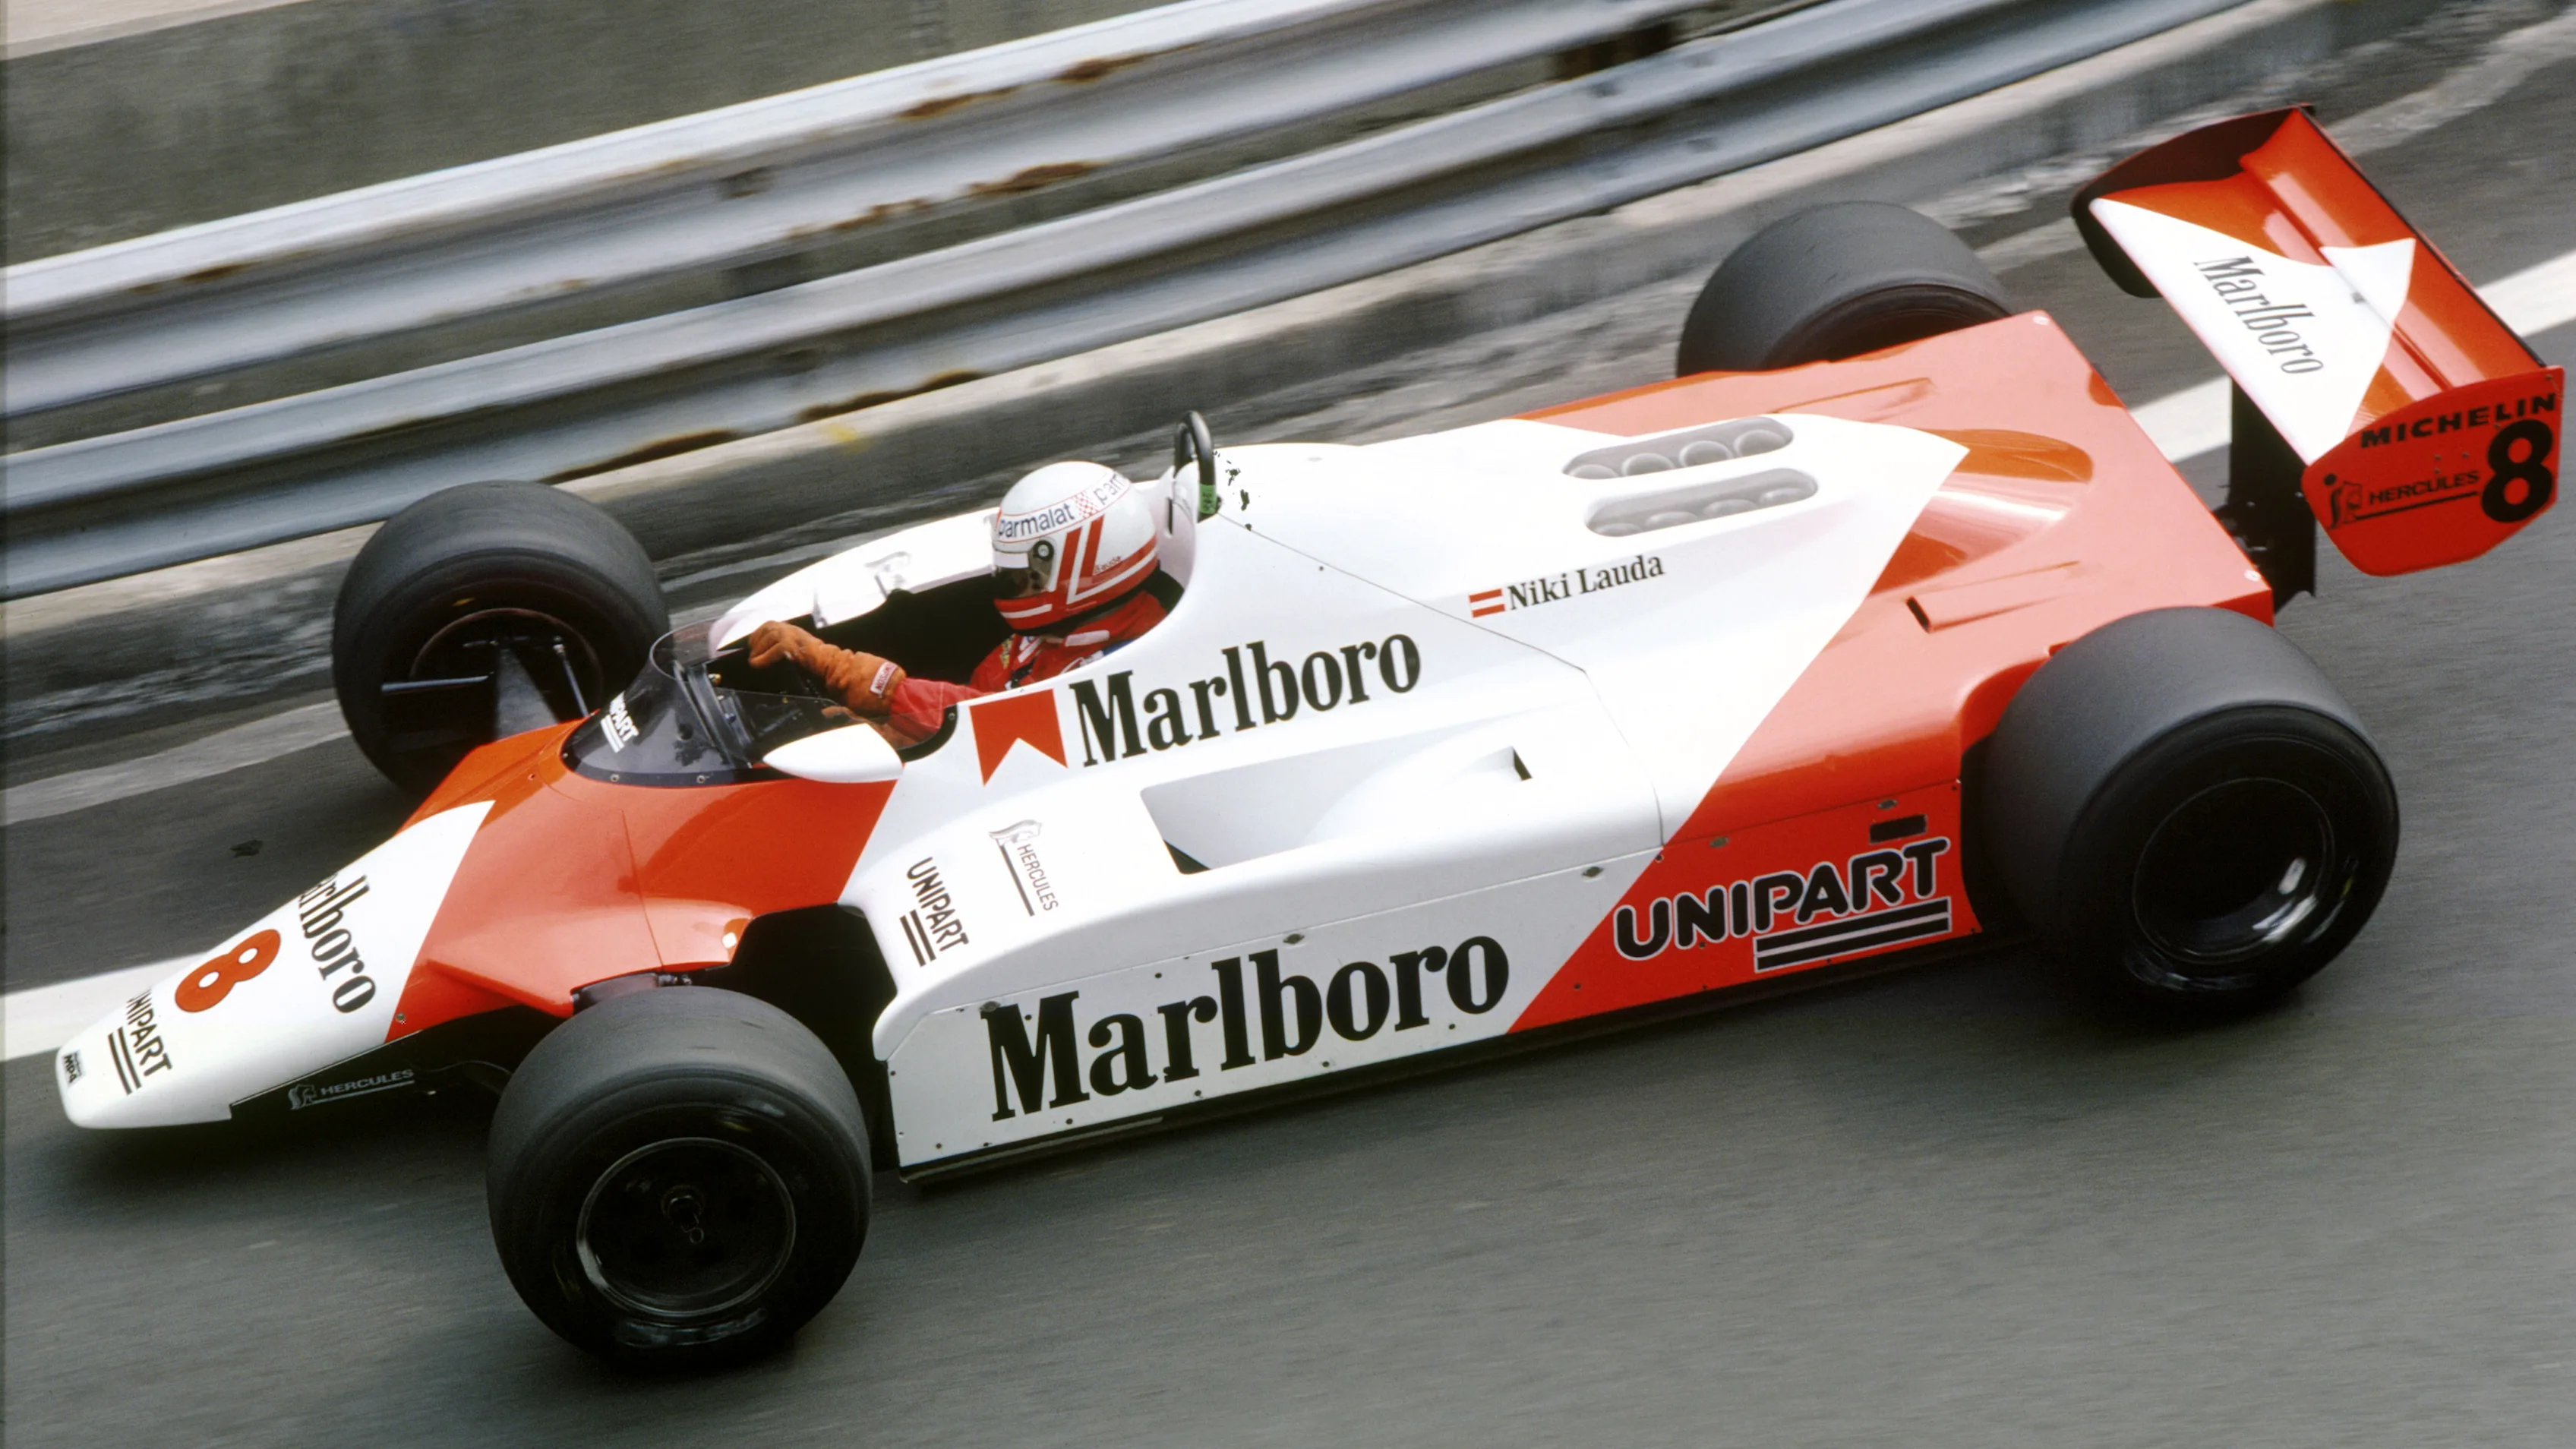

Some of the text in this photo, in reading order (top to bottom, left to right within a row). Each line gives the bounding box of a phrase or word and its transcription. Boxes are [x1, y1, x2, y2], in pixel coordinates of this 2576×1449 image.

[2192, 255, 2324, 374] Marlboro
[2360, 393, 2556, 449] MICHELIN
[2368, 469, 2481, 506] HERCULES
[2480, 418, 2554, 524] 8
[1507, 554, 1666, 611] Niki Lauda
[1068, 633, 1422, 768] Marlboro
[906, 856, 970, 952] UNIPART
[1016, 843, 1059, 911] HERCULES
[1612, 836, 1951, 961] UNIPART
[175, 928, 282, 1013] 8
[298, 873, 377, 1014] rlboro
[980, 935, 1510, 1122] Marlboro
[320, 1069, 415, 1096] HERCULES
